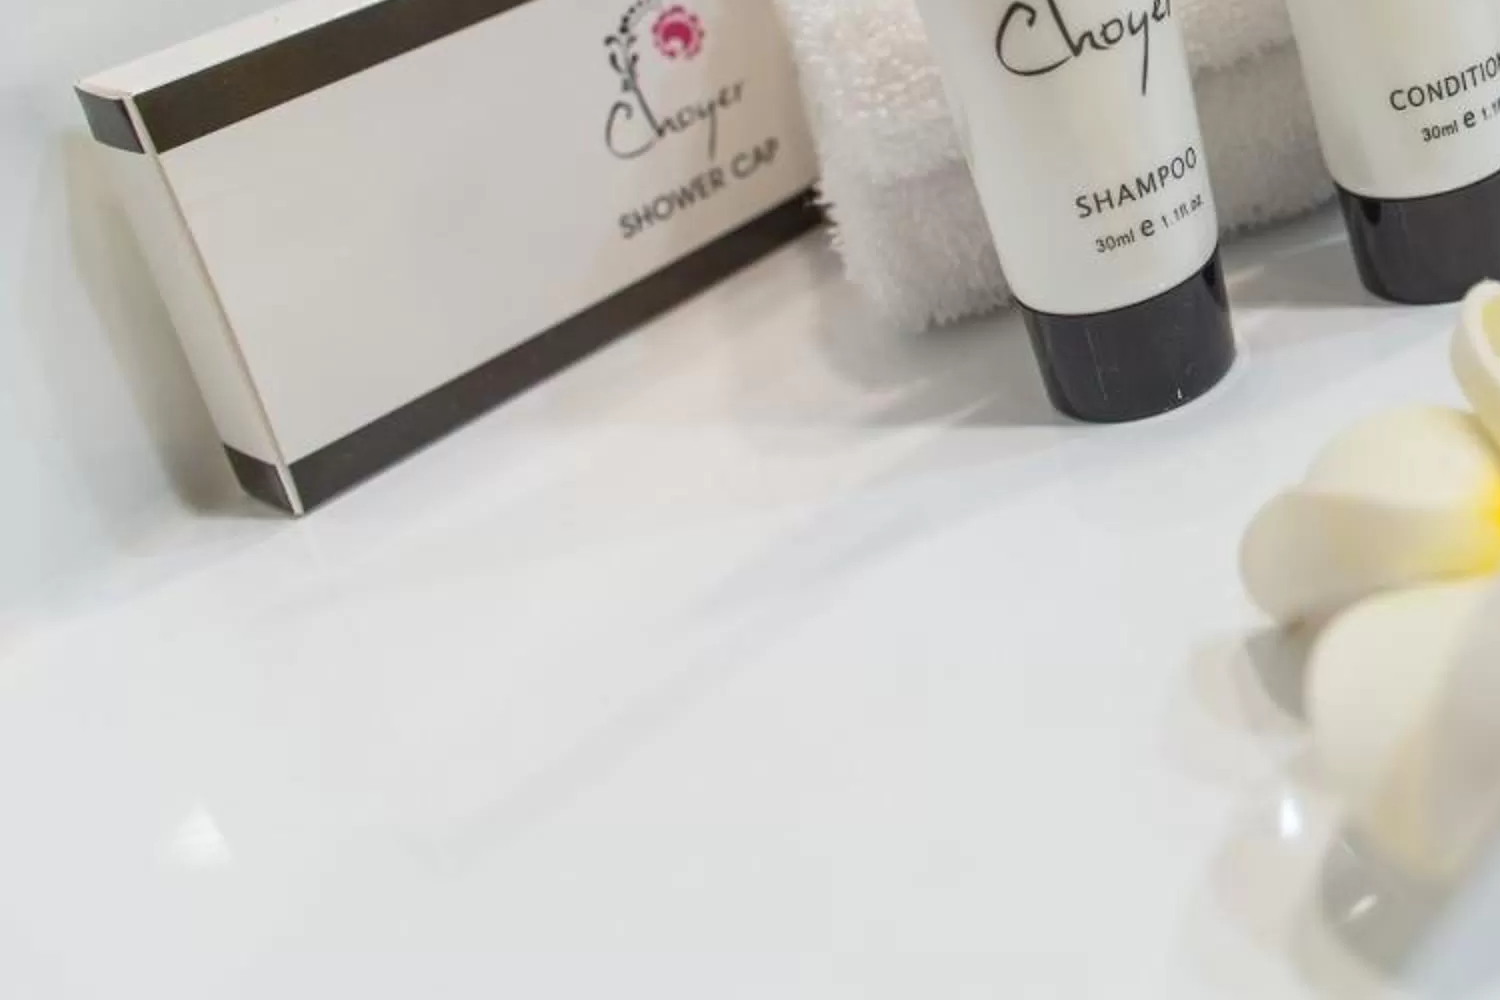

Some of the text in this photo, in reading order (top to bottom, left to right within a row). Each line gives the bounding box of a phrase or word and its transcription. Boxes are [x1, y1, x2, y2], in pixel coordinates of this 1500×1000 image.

[604, 70, 745, 162] Choyer
[1421, 118, 1459, 143] 30ml
[618, 135, 779, 240] SHOWER CAP
[1074, 145, 1198, 220] SHAMPOO
[1095, 227, 1136, 253] 30ml
